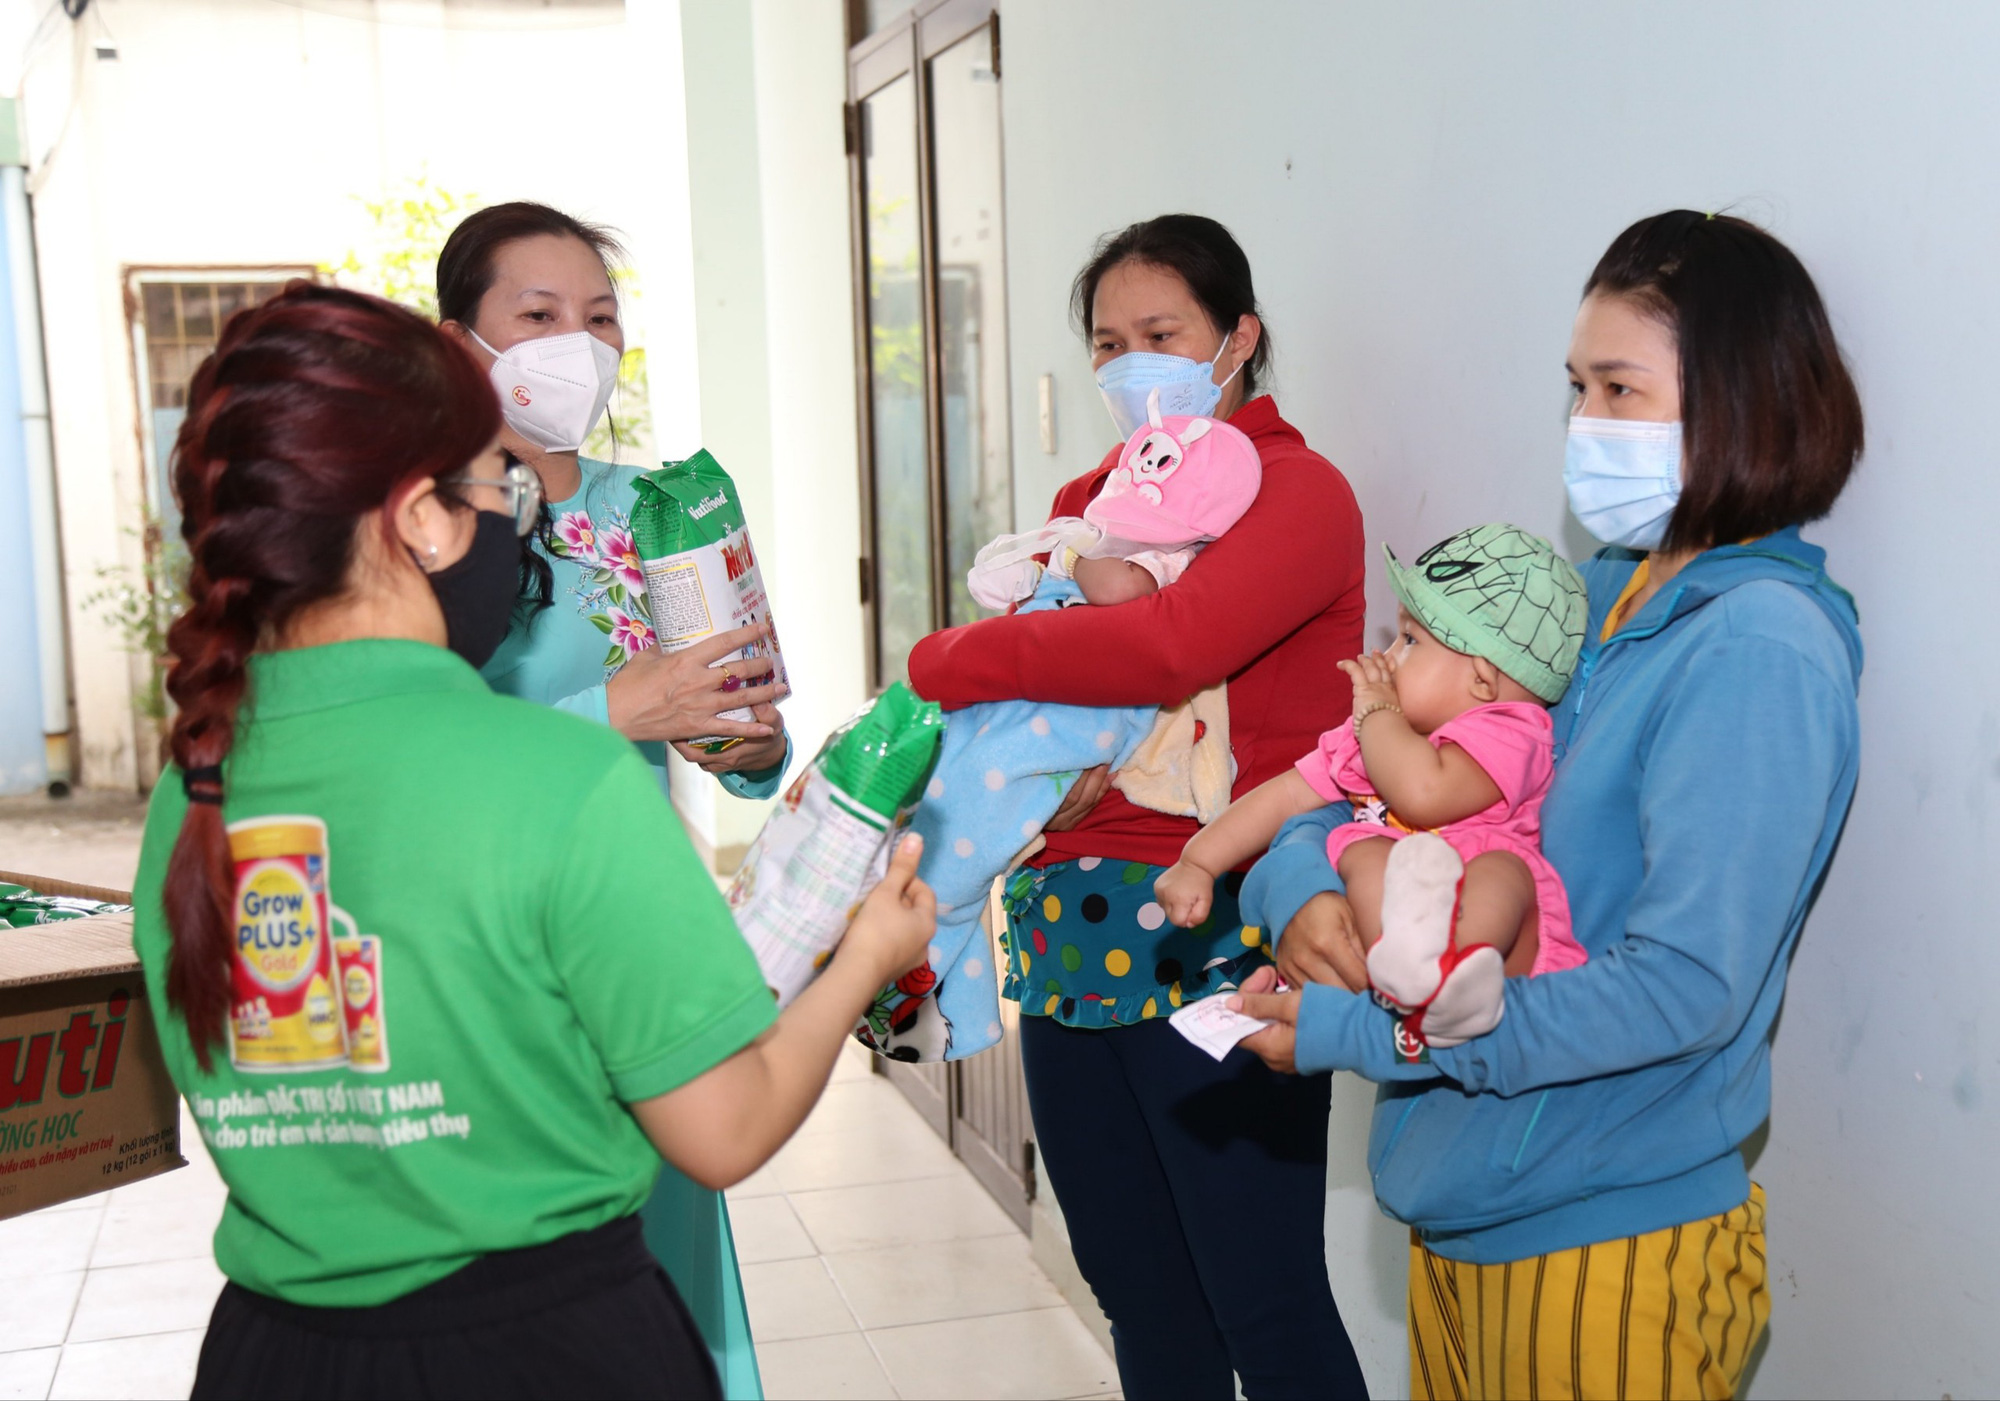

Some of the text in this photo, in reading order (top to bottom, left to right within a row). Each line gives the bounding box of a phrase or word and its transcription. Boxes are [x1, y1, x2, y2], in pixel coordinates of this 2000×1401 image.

[243, 891, 303, 917] Grow
[238, 920, 316, 953] PLUS+
[261, 953, 298, 972] Gold
[387, 1080, 444, 1113] NAM
[40, 1109, 84, 1149] HỌC
[215, 1122, 248, 1149] cho
[102, 1162, 112, 1175] 12
[114, 1159, 124, 1173] kg
[126, 1153, 138, 1170] (12
[139, 1147, 152, 1165] gói
[152, 1147, 158, 1157] x
[159, 1143, 164, 1155] 1
[119, 1138, 138, 1156] Khối
